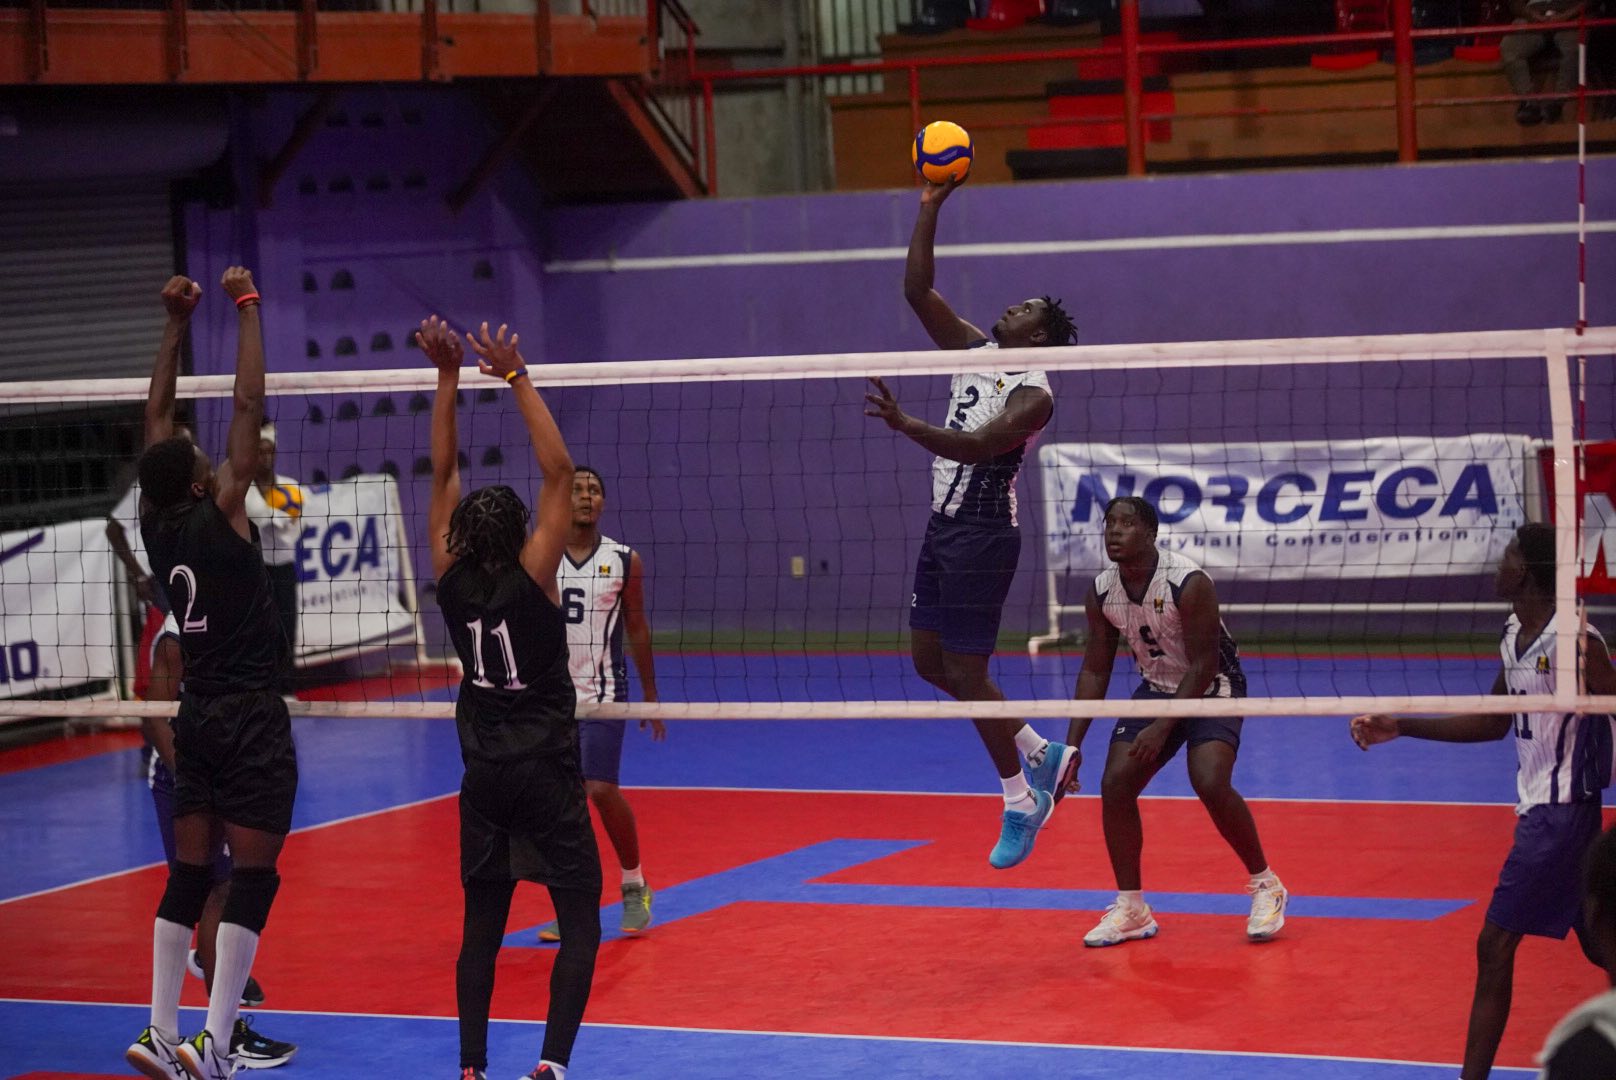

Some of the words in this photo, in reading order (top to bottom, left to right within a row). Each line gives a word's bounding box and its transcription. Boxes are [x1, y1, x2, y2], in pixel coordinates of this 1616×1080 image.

[949, 385, 979, 431] 2
[1071, 463, 1499, 524] NORCECA
[1159, 532, 1242, 549] eyball
[1266, 528, 1468, 547] Confederation
[169, 564, 208, 633] 2
[562, 587, 585, 624] 6
[466, 618, 528, 690] 11
